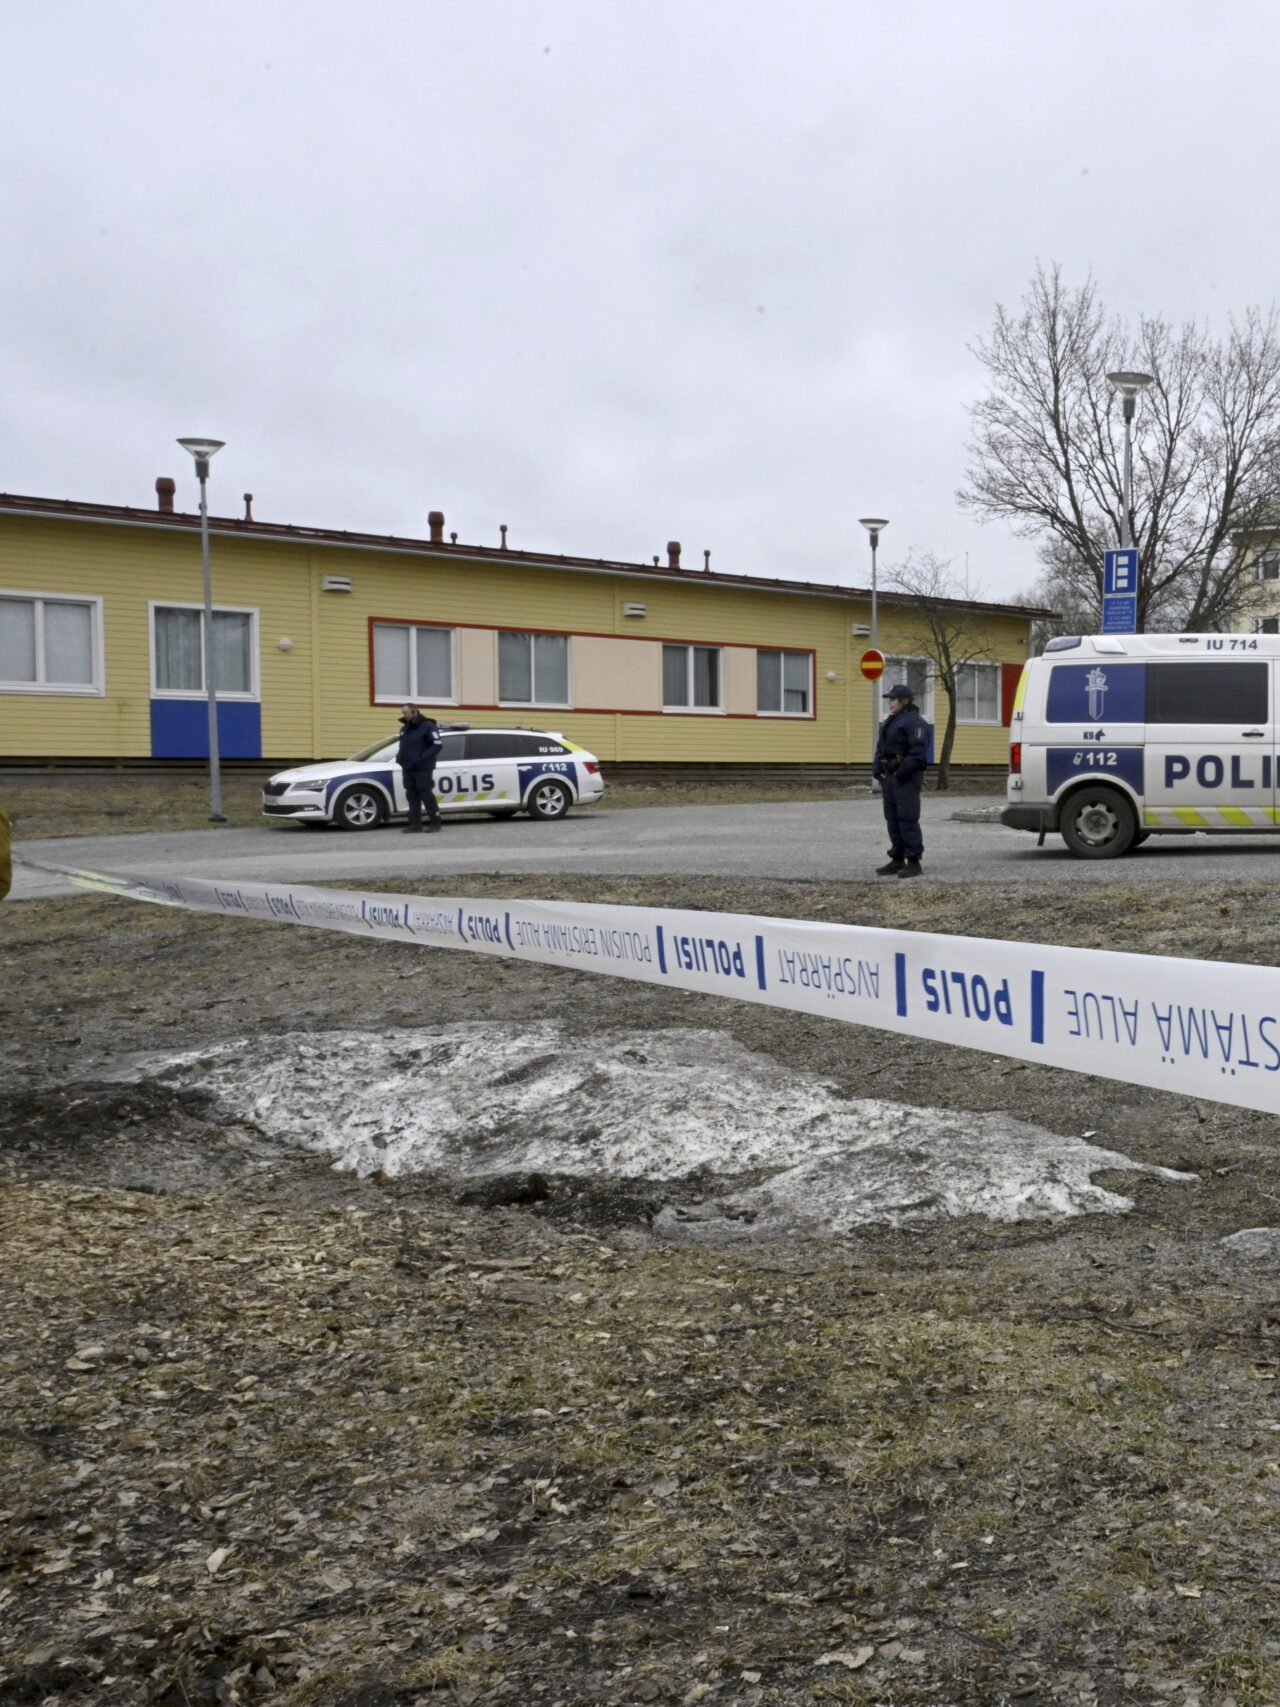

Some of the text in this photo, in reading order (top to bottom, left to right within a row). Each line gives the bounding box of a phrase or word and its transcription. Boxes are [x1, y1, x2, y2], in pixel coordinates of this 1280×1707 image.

[1206, 639, 1258, 650] IU 714
[1083, 731, 1094, 740] K9
[548, 762, 568, 772] 112
[1086, 752, 1117, 766] 112
[438, 773, 495, 794] OLIS
[467, 916, 503, 944] POLIS
[515, 921, 652, 963] POLIISIN ERISTÄMÄ ALUE
[673, 935, 746, 978] POLIISI
[777, 948, 880, 1000] AVSPÄRRAT
[921, 967, 1013, 1027] POLIS
[1063, 988, 1139, 1047] ALUE
